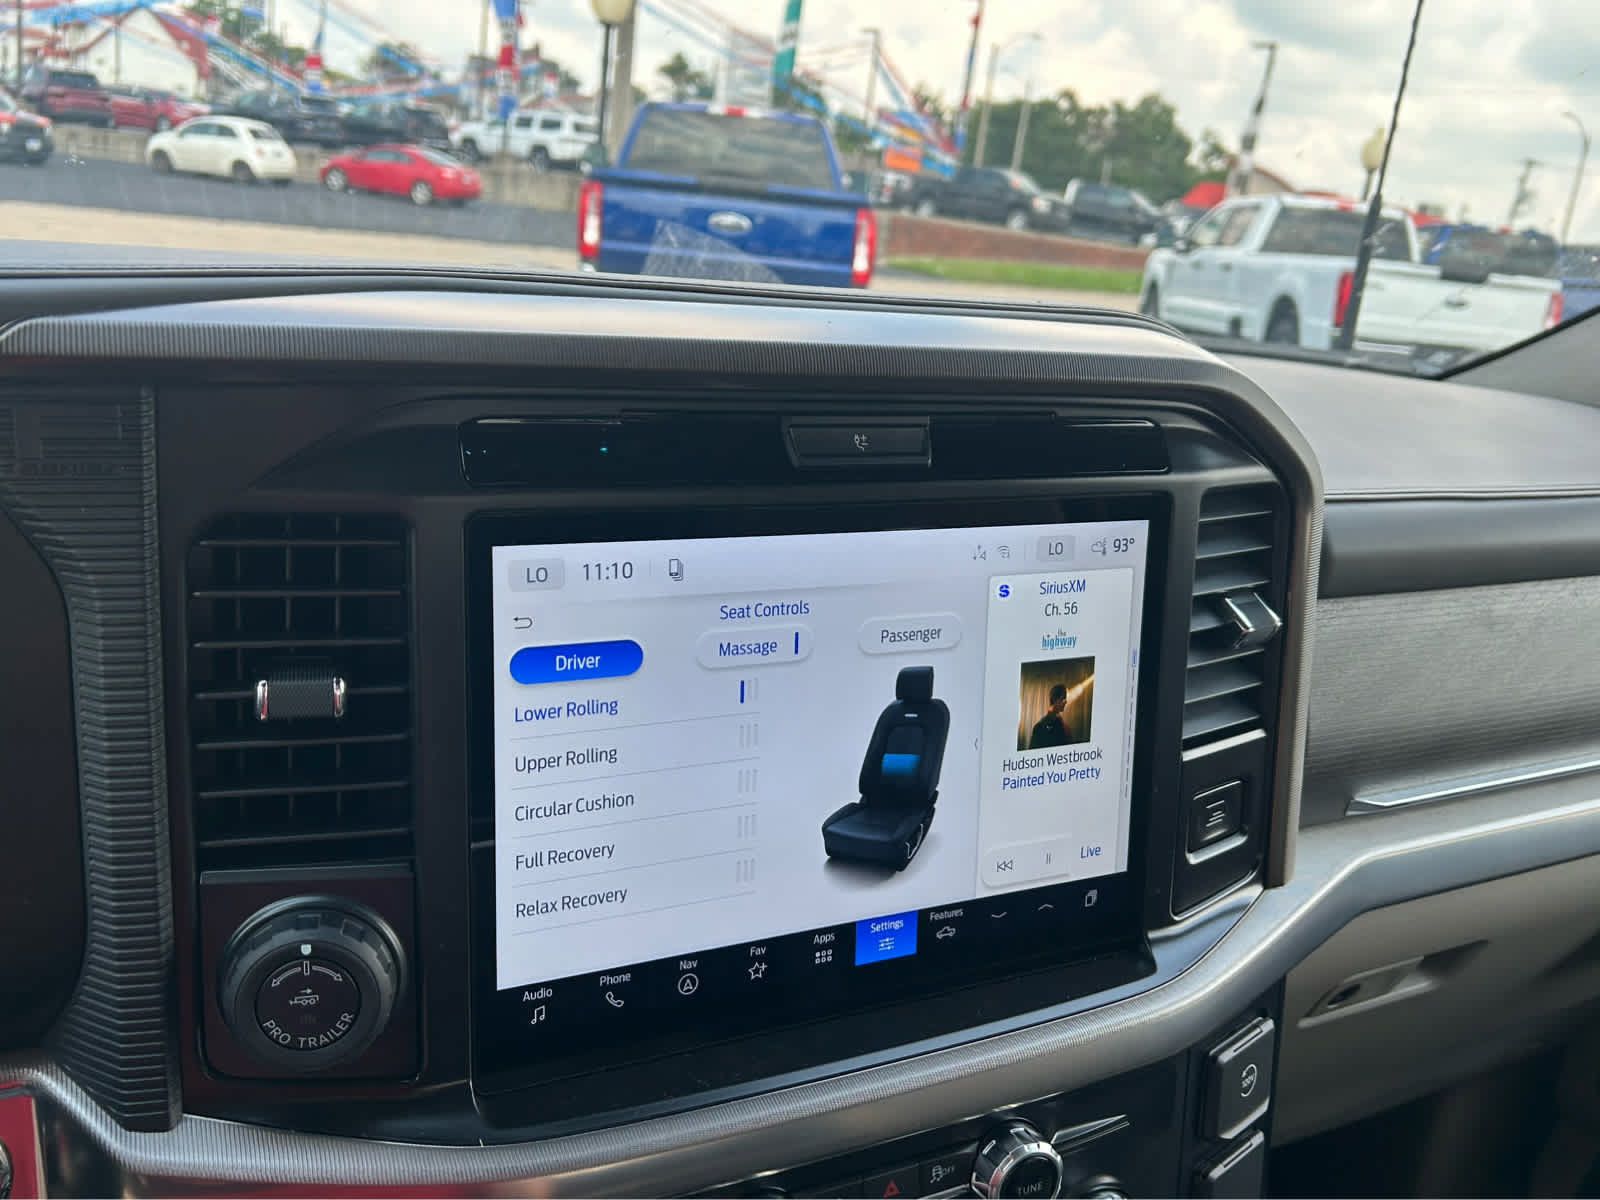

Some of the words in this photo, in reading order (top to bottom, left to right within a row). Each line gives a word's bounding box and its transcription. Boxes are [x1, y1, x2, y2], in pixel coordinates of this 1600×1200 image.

[1048, 542, 1064, 555] LO
[1113, 538, 1135, 552] 93°
[526, 567, 548, 583] LO
[582, 561, 634, 581] 11:10
[1039, 578, 1087, 595] SiriusXM
[719, 603, 752, 620] Seat
[754, 599, 810, 618] Controls
[1044, 602, 1062, 617] Ch.
[1063, 601, 1078, 616] 56
[880, 625, 943, 644] Passenger
[1041, 634, 1077, 650] highway
[718, 639, 778, 658] Massage
[555, 654, 602, 672] Driver
[514, 703, 563, 723] Lower
[565, 698, 619, 717] Rolling
[515, 753, 562, 774] Upper
[565, 747, 618, 766] Rolling
[1002, 756, 1044, 773] Hudson
[1046, 748, 1102, 767] Westbrook
[1002, 771, 1045, 790] Painted
[1047, 770, 1066, 785] You
[1068, 766, 1101, 782] Pretty
[514, 801, 573, 822] Circular
[575, 793, 635, 813] Cushion
[515, 850, 544, 871] Full
[547, 843, 615, 866] Recovery
[1080, 845, 1101, 859] Live
[515, 897, 559, 919] Relax
[561, 888, 628, 912] Recovery
[929, 908, 964, 921] Features
[869, 919, 904, 934] Settings
[813, 932, 835, 945] Apps
[749, 946, 767, 957] Fav
[679, 959, 698, 971] Nav
[599, 973, 632, 986] Phone
[522, 987, 553, 1002] Audio
[262, 1019, 292, 1045] PRO
[298, 1012, 354, 1048] TRAILER
[1017, 1182, 1042, 1196] TUNE
